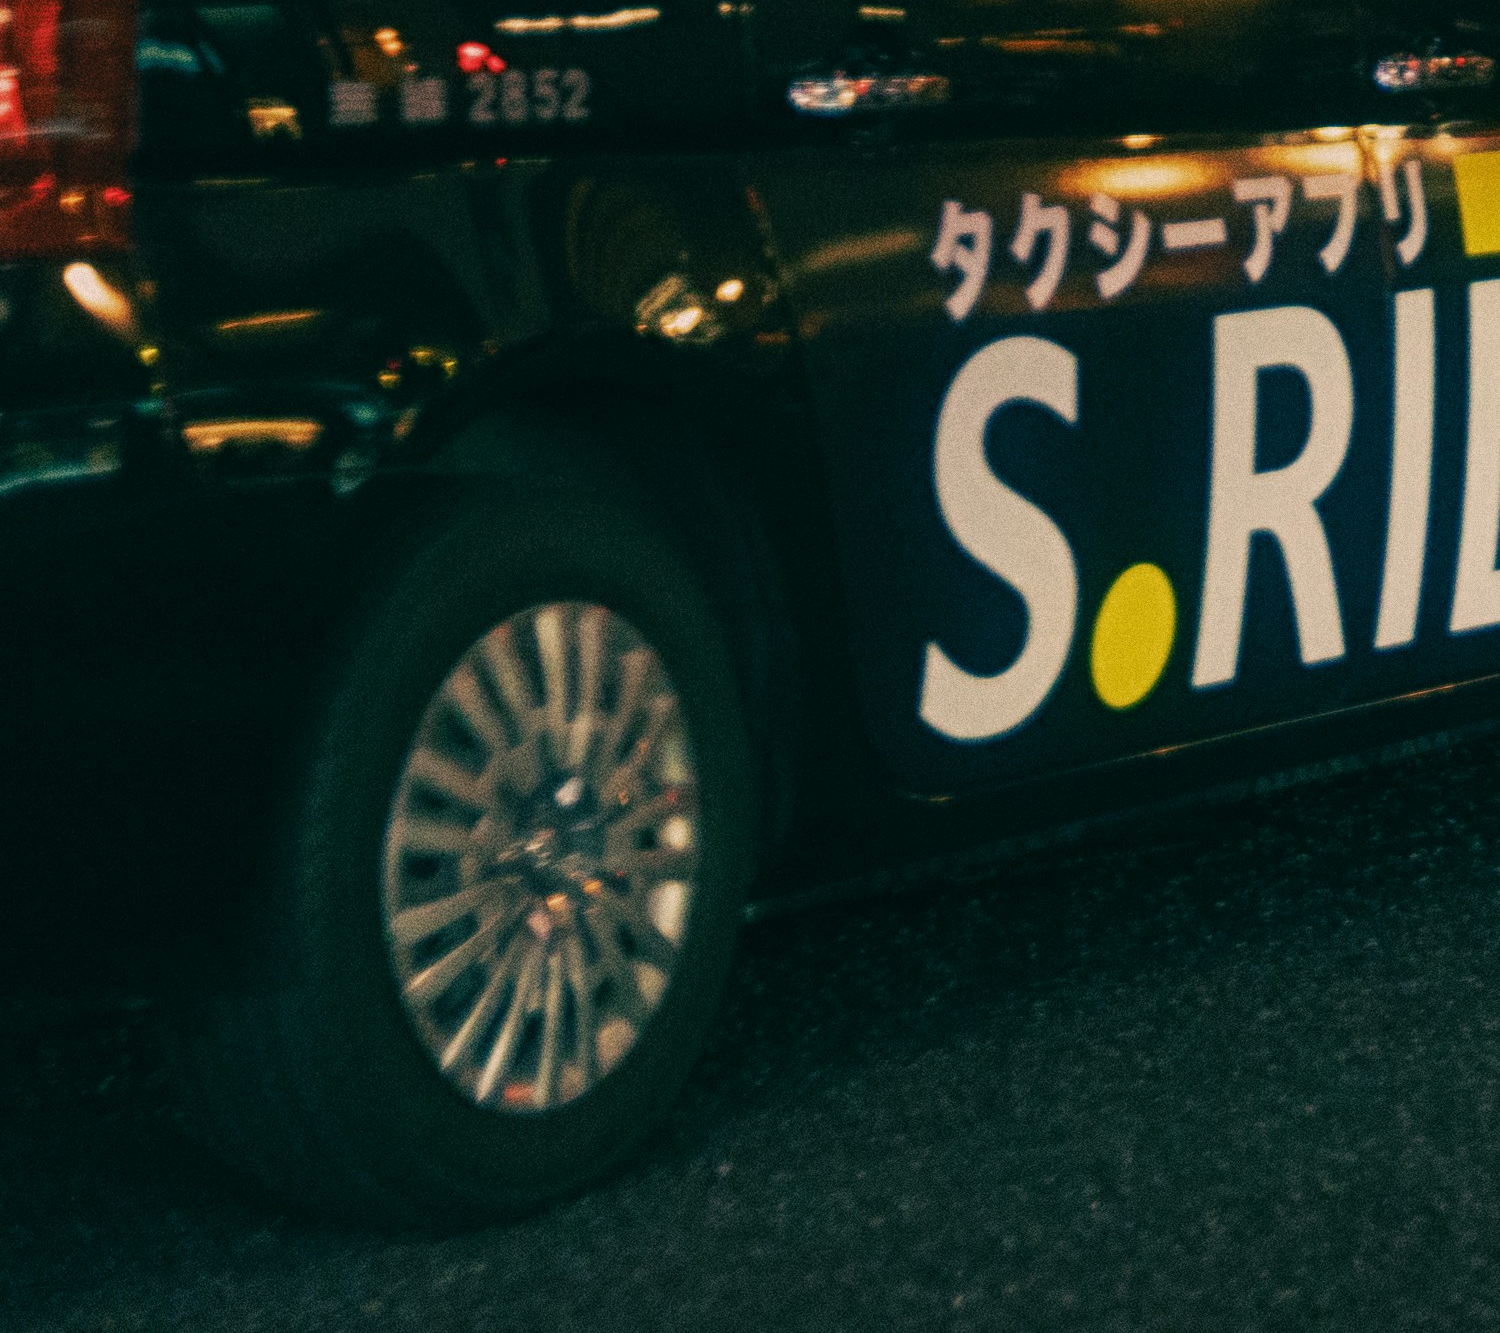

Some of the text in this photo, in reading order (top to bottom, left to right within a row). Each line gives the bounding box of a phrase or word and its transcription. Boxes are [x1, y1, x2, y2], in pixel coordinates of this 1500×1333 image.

[469, 68, 589, 123] 2852
[930, 159, 1428, 322] タクシーアプリ
